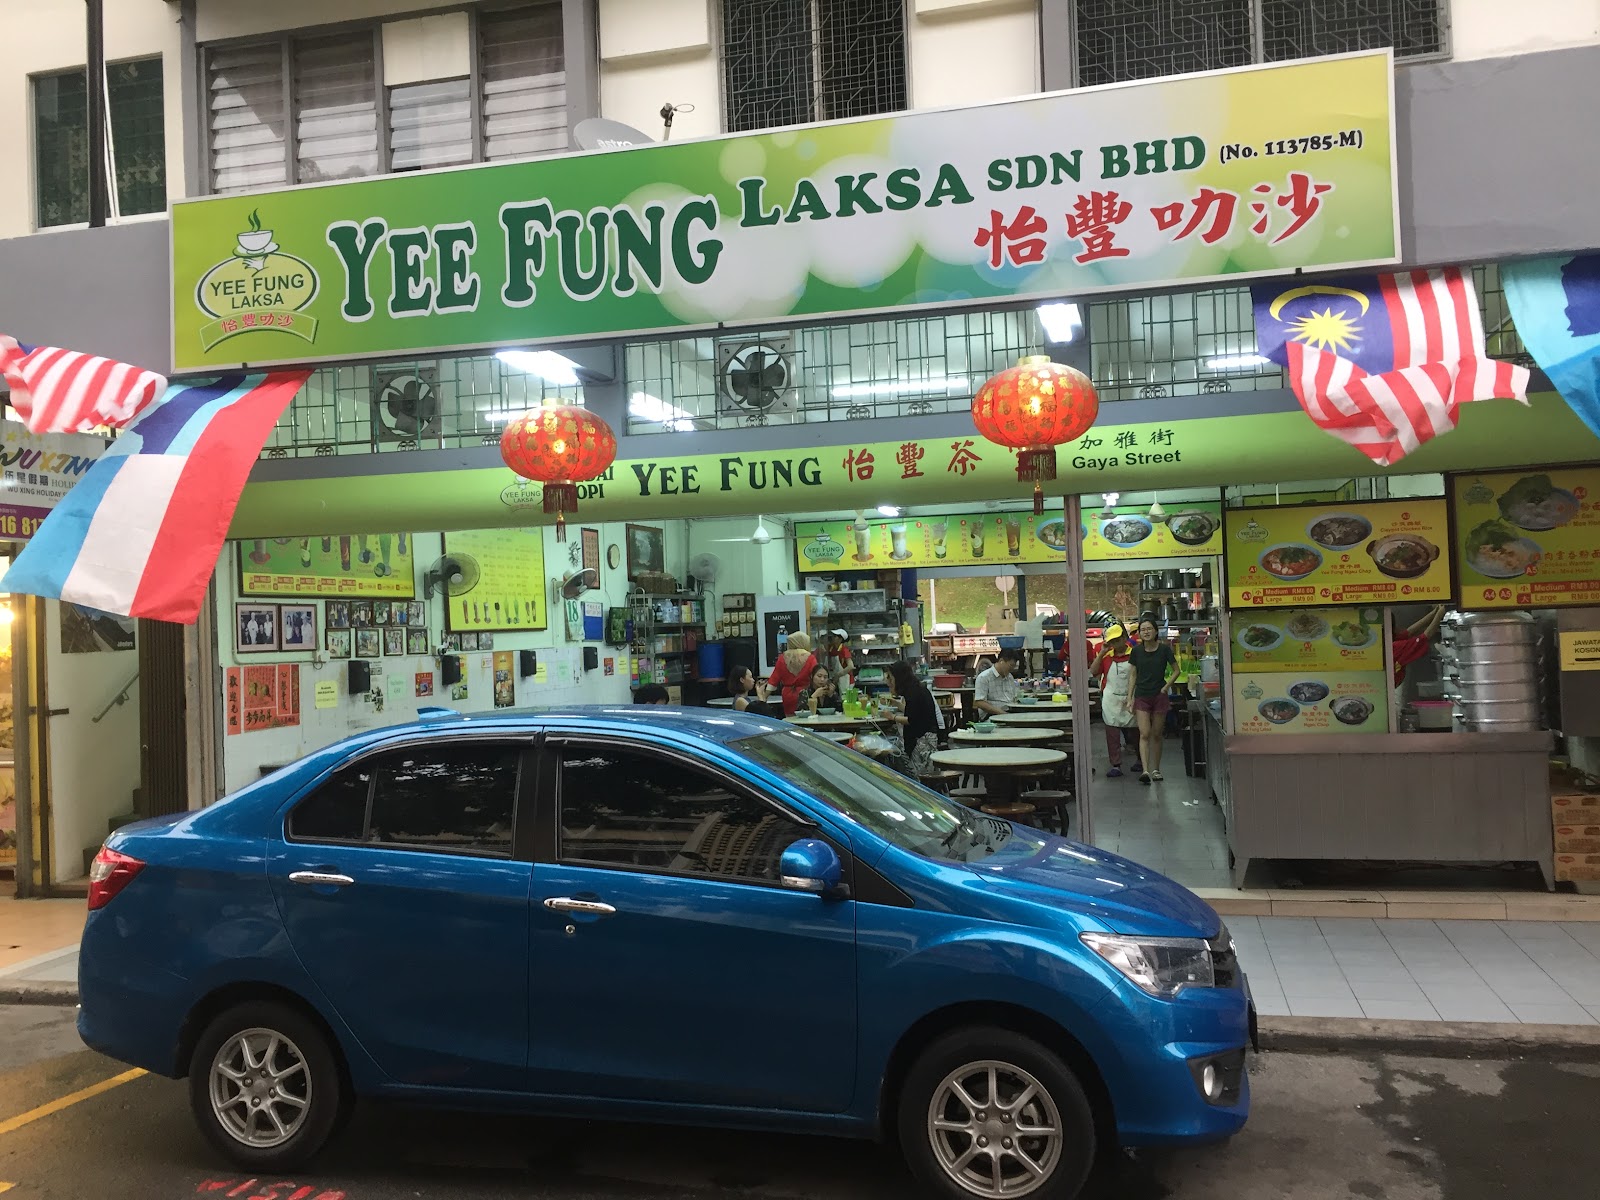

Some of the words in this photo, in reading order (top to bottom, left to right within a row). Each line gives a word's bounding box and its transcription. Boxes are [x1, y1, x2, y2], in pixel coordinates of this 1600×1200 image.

[739, 163, 975, 229] LAKSA
[987, 149, 1083, 191] SDN
[1100, 135, 1206, 179] BHD
[1219, 143, 1258, 165] (No.
[1264, 130, 1363, 157] 113785-M)
[973, 173, 1332, 268] 怡豐叻沙
[326, 217, 481, 321] YEE
[499, 194, 724, 307] FUNG
[210, 279, 246, 297] YEE
[253, 273, 304, 293] FUNG
[231, 292, 285, 310] LAKSA
[221, 313, 294, 334] 怡豐叻沙
[1079, 428, 1175, 450] 加雅街
[1072, 455, 1119, 471] Gaya
[1125, 449, 1182, 466] Street
[631, 463, 701, 496] YEE
[720, 456, 823, 491] FUNG
[1534, 594, 1557, 602] Large
